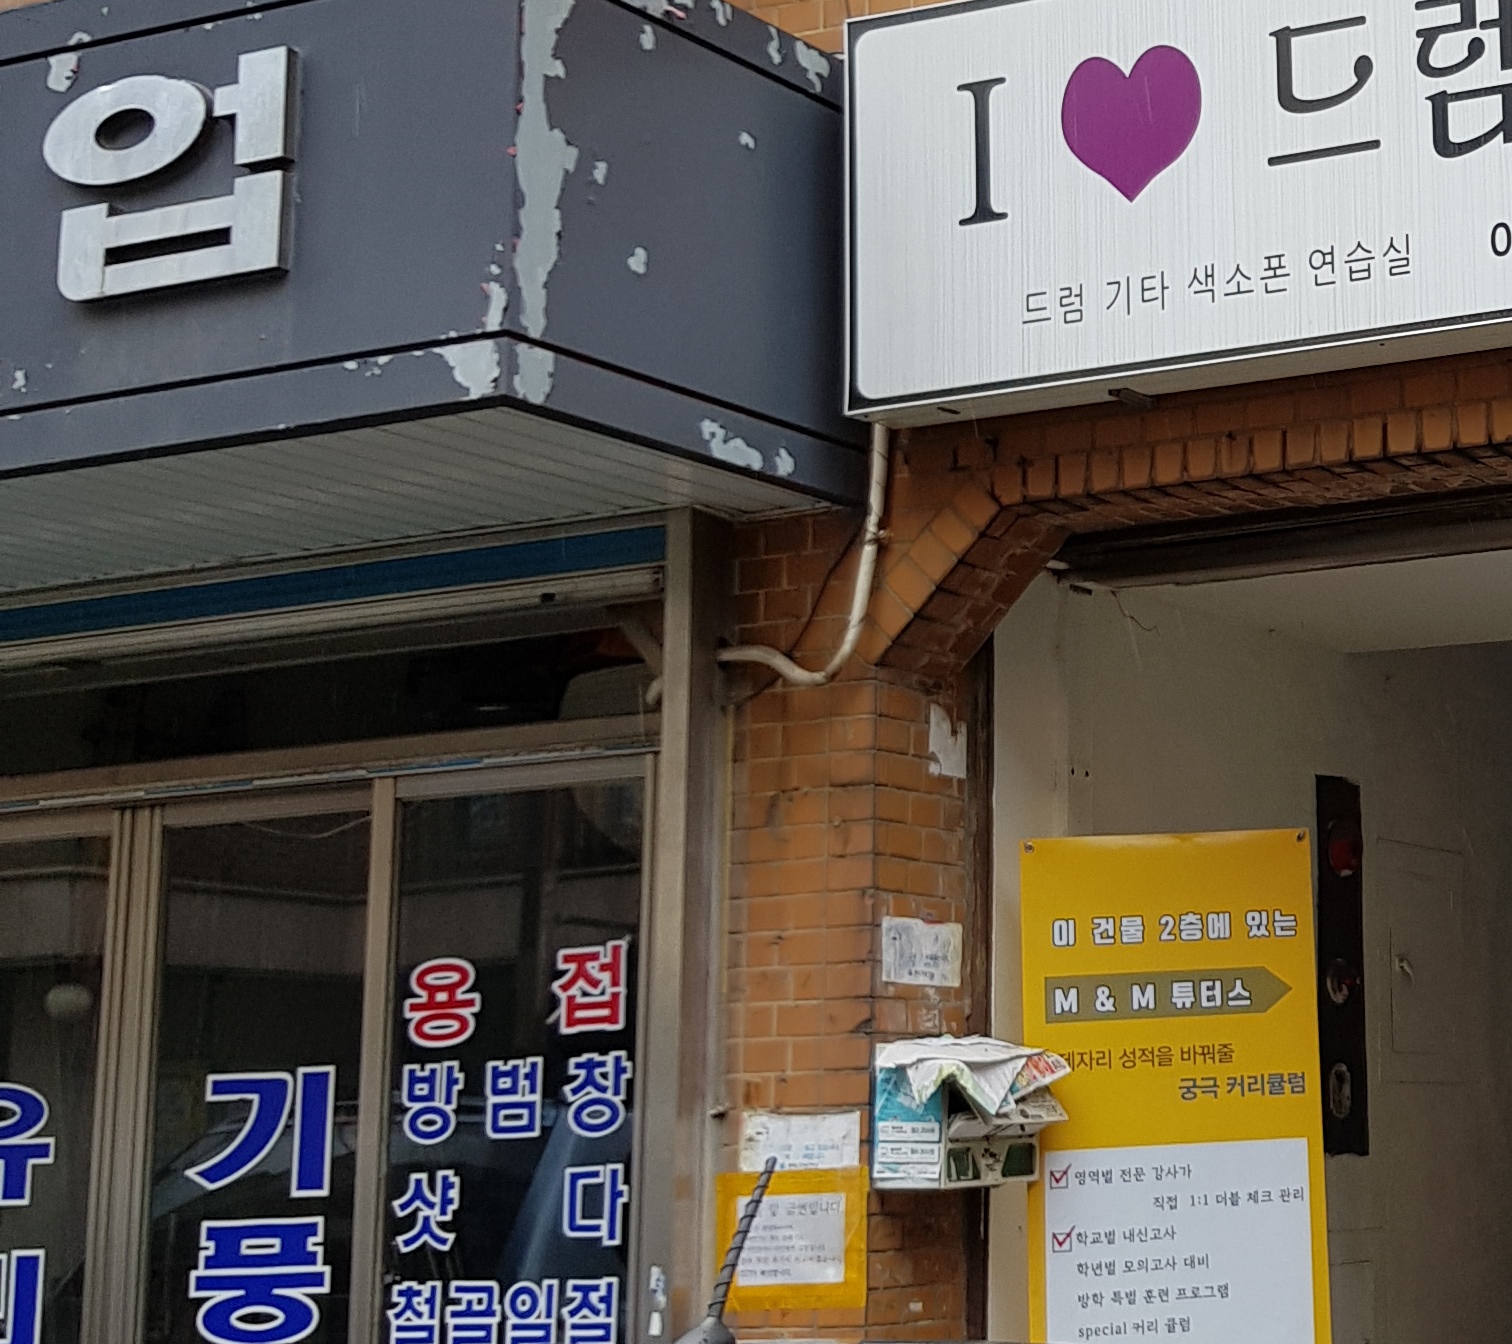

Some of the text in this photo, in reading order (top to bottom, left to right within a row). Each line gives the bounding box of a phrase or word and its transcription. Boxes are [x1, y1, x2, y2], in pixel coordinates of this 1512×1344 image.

[956, 77, 1009, 226] I
[42, 46, 292, 302] 업
[1021, 231, 1414, 327] 드럼 기타 색소폰 연습실
[1052, 909, 1298, 947] 이 건물 2층에 있는
[1054, 977, 1252, 1015] M & M 튜터스
[1118, 1045, 1174, 1069] 성적을
[1180, 1042, 1235, 1065] 바꿔줄
[402, 1050, 633, 1143] 방범창
[1178, 1071, 1306, 1101] 궁극 커리큘럼
[1120, 1166, 1146, 1183] 전문
[1152, 1164, 1192, 1181] 강사가
[1153, 1194, 1178, 1211] 직접
[1190, 1194, 1209, 1206] 1:1
[1279, 1186, 1305, 1203] 관리
[1123, 1225, 1177, 1243] 내신고사
[1122, 1255, 1177, 1274] 모의고사
[1184, 1253, 1210, 1270] 대비
[1078, 1291, 1105, 1308] 방학
[1175, 1283, 1230, 1300] 프로그램
[1078, 1322, 1128, 1341] special
